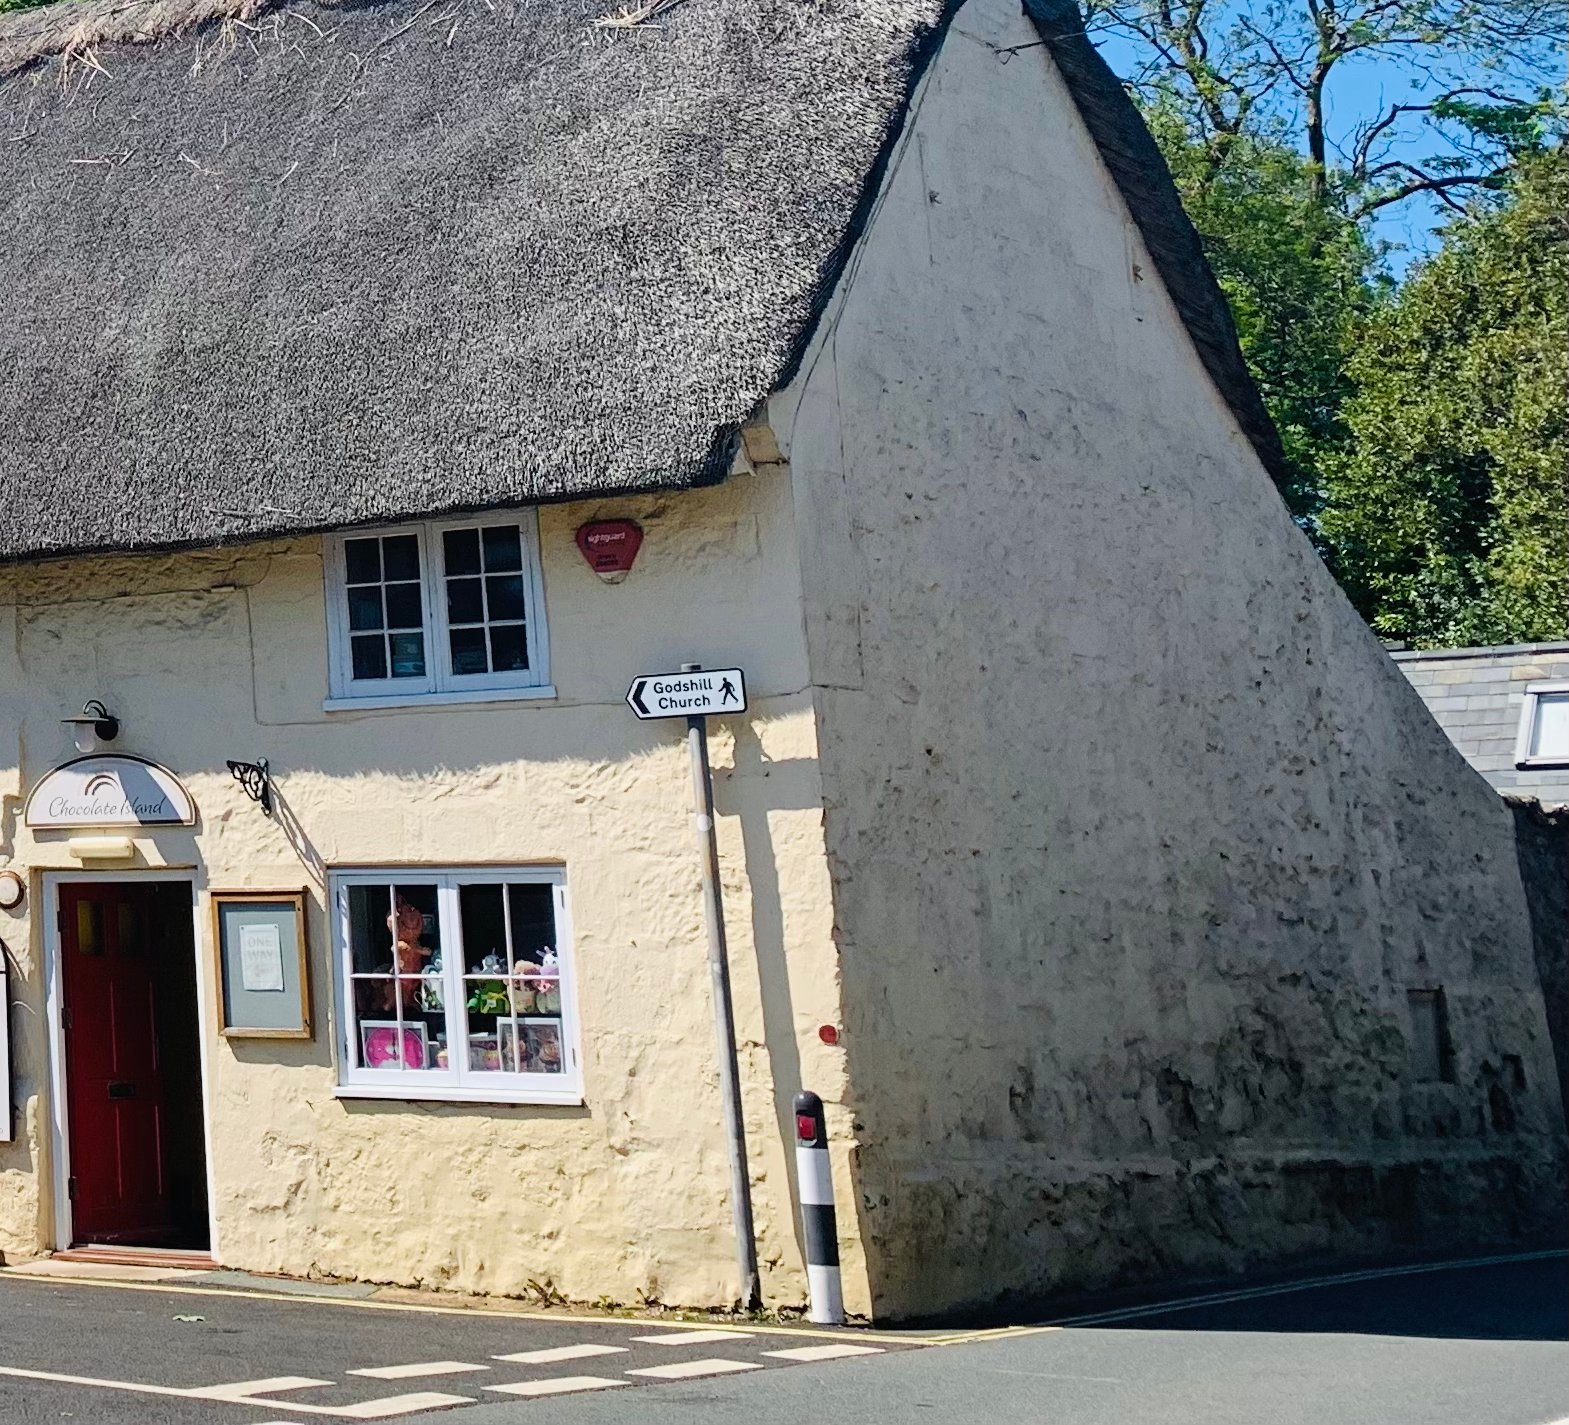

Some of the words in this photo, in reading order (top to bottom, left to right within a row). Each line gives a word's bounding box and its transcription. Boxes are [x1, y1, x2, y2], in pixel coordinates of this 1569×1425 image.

[653, 678, 713, 694] Godshill
[658, 694, 711, 710] Church
[48, 795, 117, 818] Chocolate
[120, 795, 167, 817] Island
[248, 936, 273, 948] ONE
[248, 950, 273, 961] WAY
